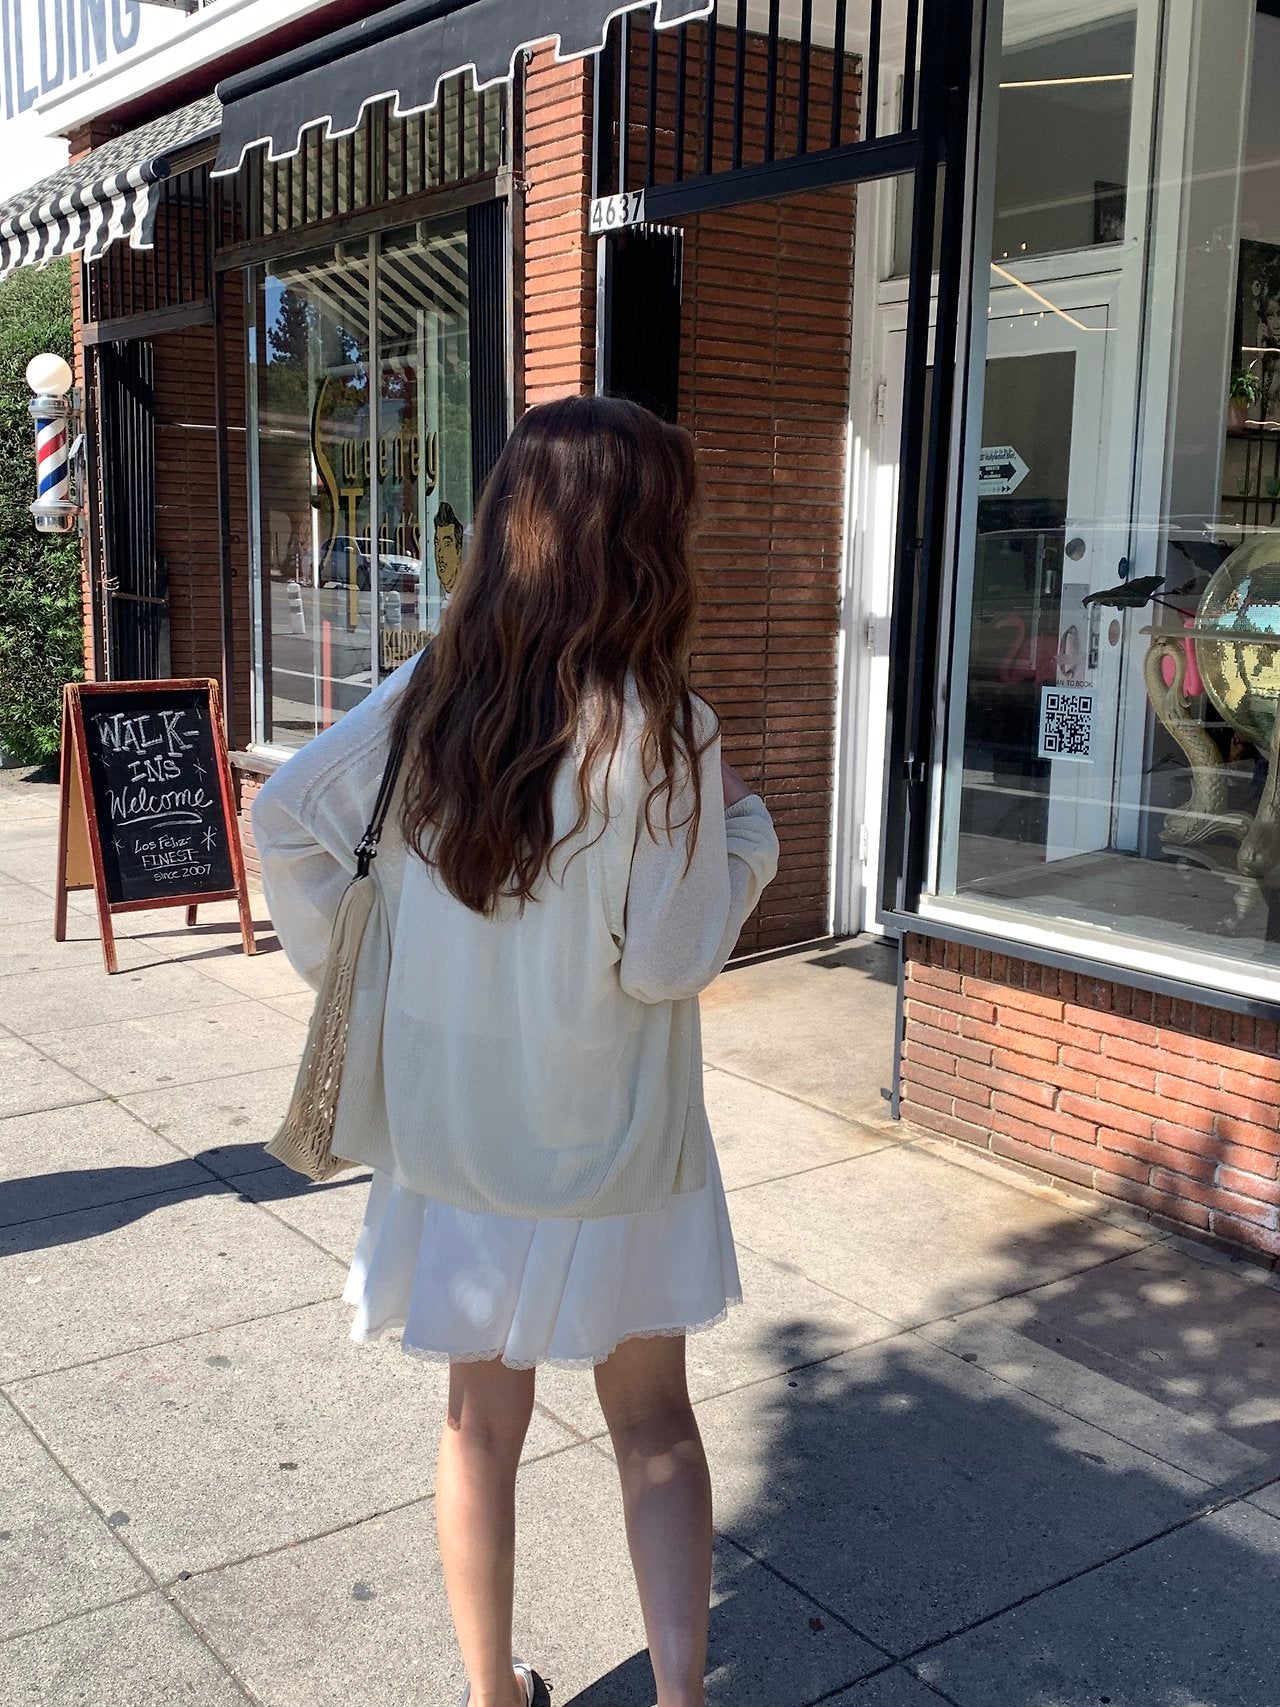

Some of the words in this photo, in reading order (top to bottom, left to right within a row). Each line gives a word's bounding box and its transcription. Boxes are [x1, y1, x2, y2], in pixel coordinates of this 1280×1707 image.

[0, 0, 140, 120] ILDING
[593, 190, 643, 228] 4637
[1075, 680, 1093, 688] BOOK
[91, 710, 199, 757] WALK-
[127, 755, 181, 783] INS
[105, 786, 213, 820] Welcome
[134, 839, 157, 854] Los
[142, 848, 196, 868] FINEST
[154, 871, 181, 882] since
[182, 864, 211, 877] 2007
